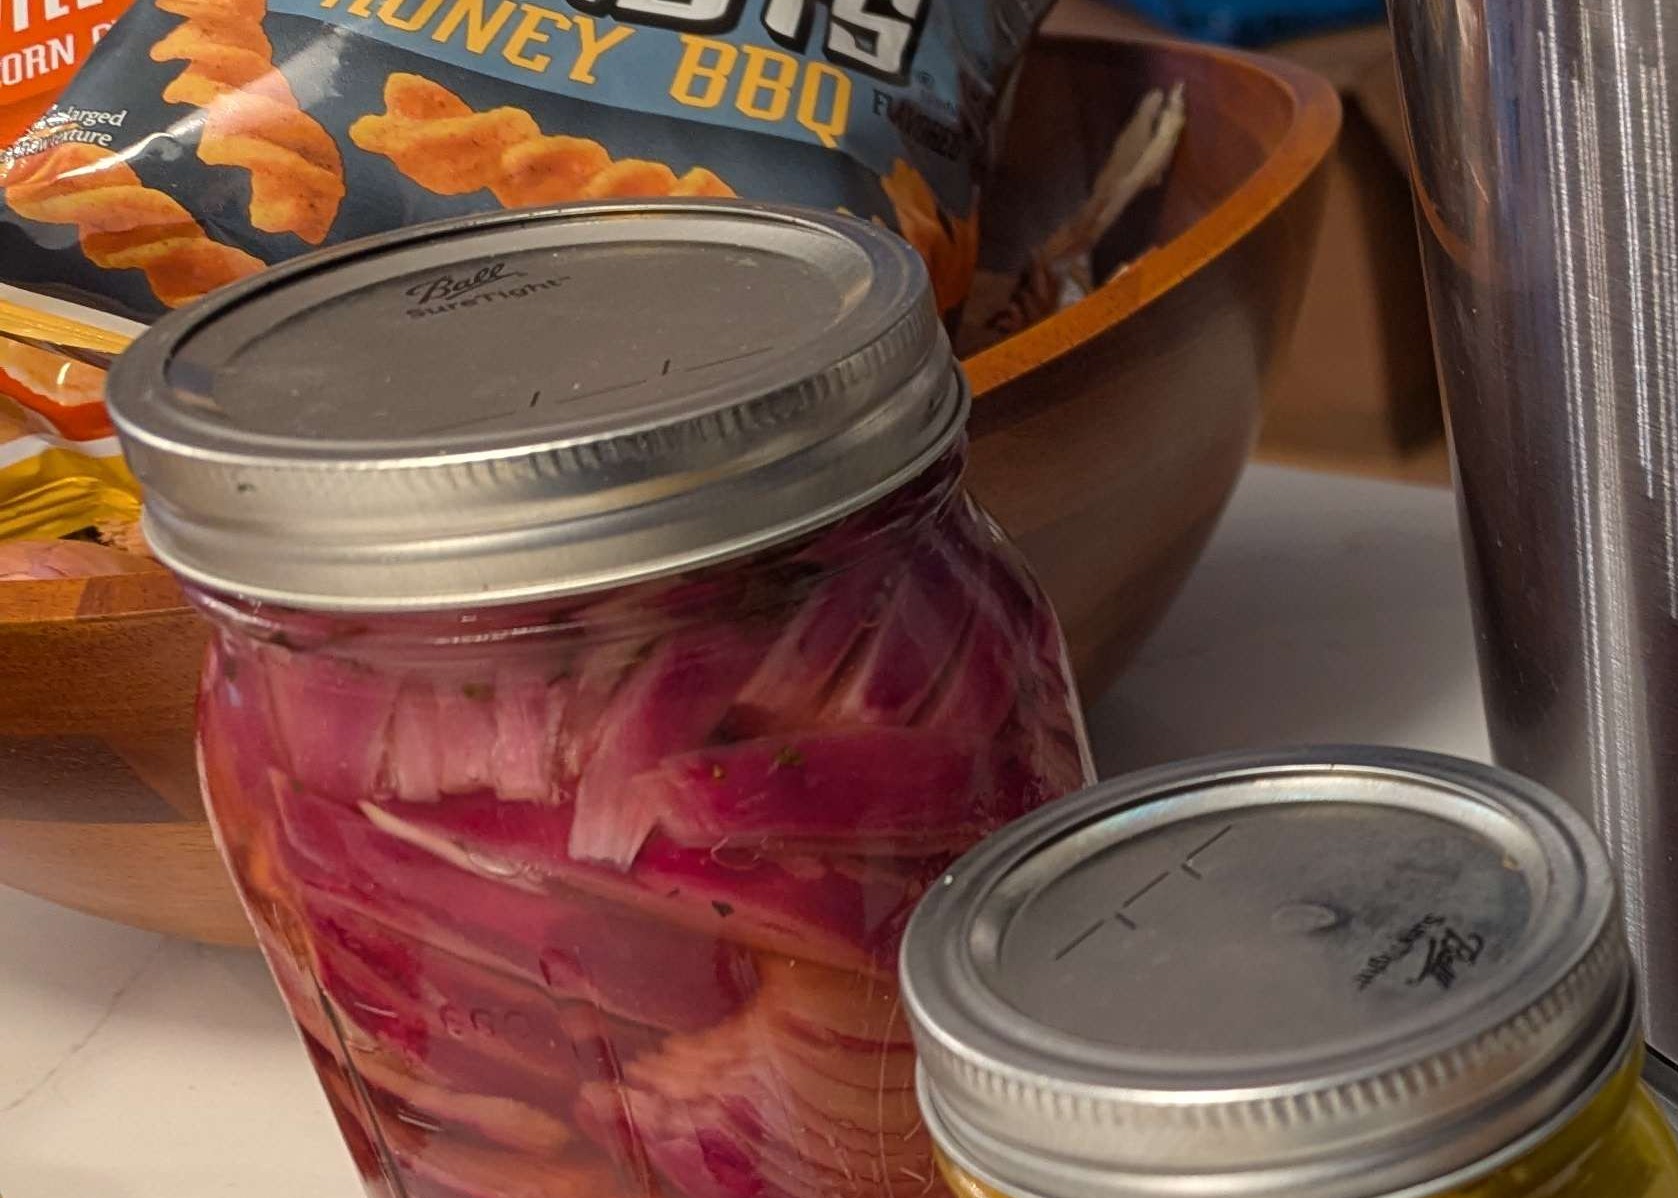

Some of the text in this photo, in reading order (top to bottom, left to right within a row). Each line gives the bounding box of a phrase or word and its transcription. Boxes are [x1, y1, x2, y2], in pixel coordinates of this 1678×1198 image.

[0, 32, 75, 87] ORN
[321, 0, 636, 84] ONEY
[669, 33, 853, 149] BBQ
[405, 262, 524, 305] Ball
